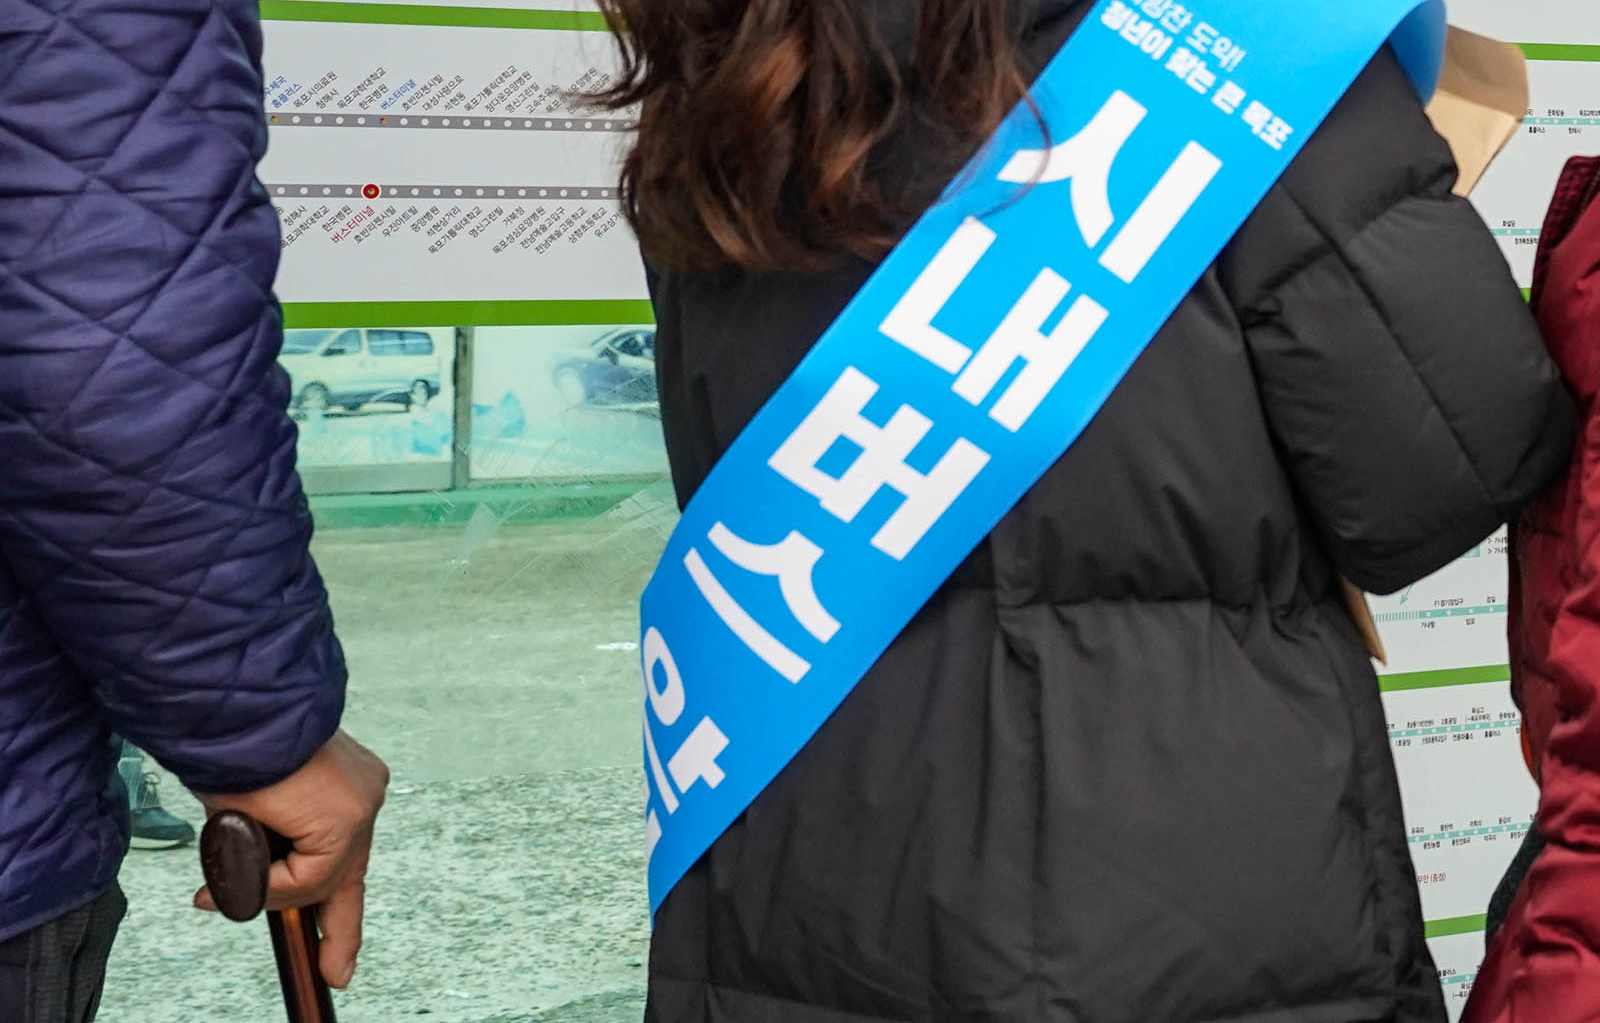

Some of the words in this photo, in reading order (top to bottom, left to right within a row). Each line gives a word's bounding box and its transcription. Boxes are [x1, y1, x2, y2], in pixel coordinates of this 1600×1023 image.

[292, 70, 336, 108] 목포시의료원
[336, 66, 386, 110] 목포과학대학교
[400, 74, 444, 110] 호반리젠시빌
[422, 74, 464, 112] 대성사랑으로
[462, 66, 518, 112] 목포가톨릭대학교
[1100, 0, 1174, 61] 청년이
[1164, 46, 1217, 96] 찾는
[1210, 79, 1247, 115] 큰
[1241, 99, 1294, 151] 목포
[270, 82, 302, 108] 홈플러스
[316, 88, 340, 108] 청해사
[358, 84, 388, 110] 한국병원
[378, 78, 416, 110] 버스터미널
[444, 90, 466, 112] 석현동
[504, 82, 540, 114] 영신그린빌
[284, 204, 308, 226] 청해사
[322, 204, 352, 232] 한국병원
[330, 206, 374, 244] 버스터미널
[352, 206, 396, 242] 호반리젠시빌
[382, 206, 418, 238] 우진아트빌
[410, 206, 440, 232] 중앙병원
[426, 206, 462, 238] 석현삼거리
[426, 206, 482, 254] 목포가톨릭대학교
[468, 206, 504, 238] 영신그린빌
[490, 206, 546, 254] 목포성심요양병원
[518, 206, 568, 248] 전남예술고입구
[534, 206, 588, 254] 전남예술고등학교
[566, 206, 608, 242] 삼향초등학교
[684, 89, 1223, 684] 시내버스
